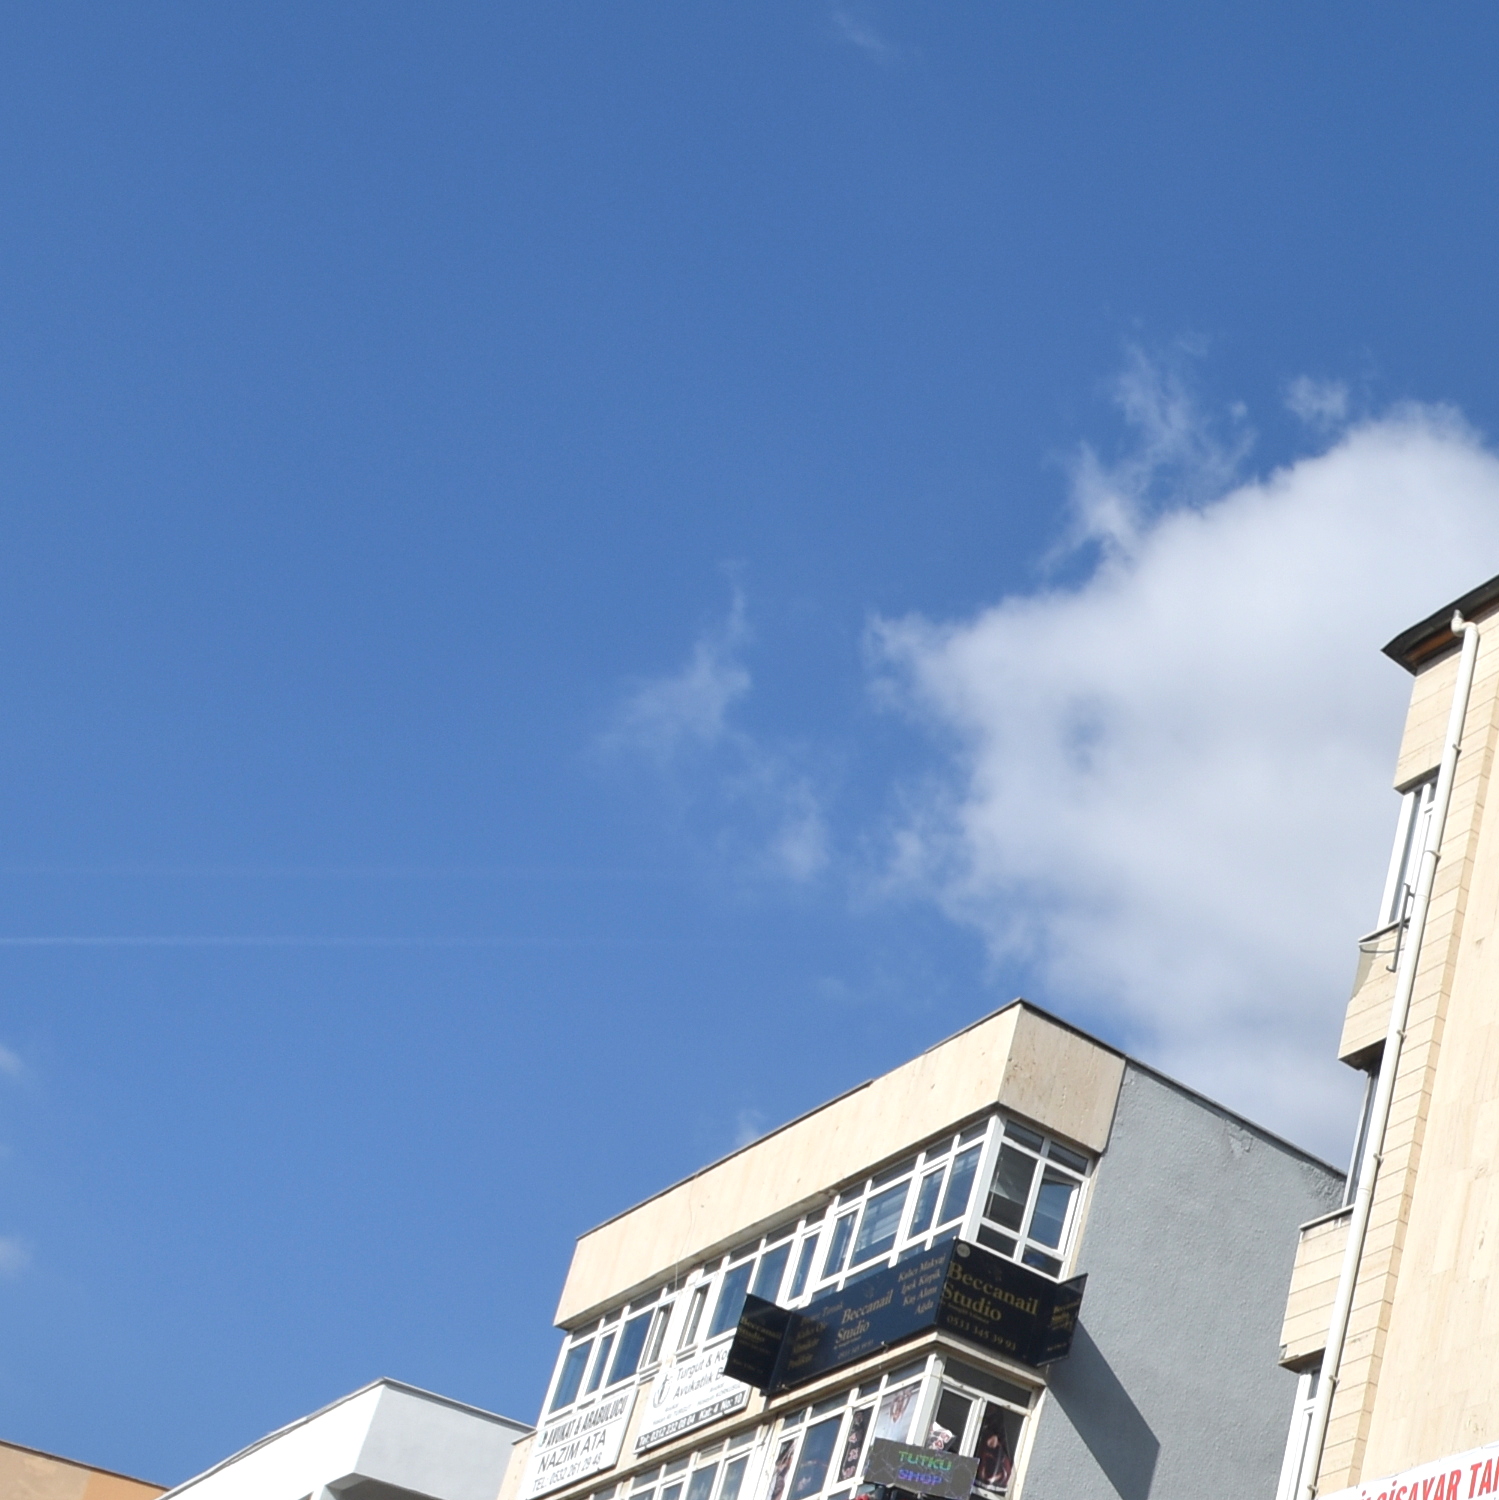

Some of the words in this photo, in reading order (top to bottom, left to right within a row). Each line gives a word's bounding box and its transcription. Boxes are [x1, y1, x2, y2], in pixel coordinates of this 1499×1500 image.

[942, 1282, 1002, 1321] Studio
[836, 1321, 870, 1344] Studio
[538, 1442, 581, 1475] NAZIM
[584, 1429, 607, 1452] ATA
[899, 1450, 953, 1472] TUTKU
[900, 1469, 943, 1486] SHOP
